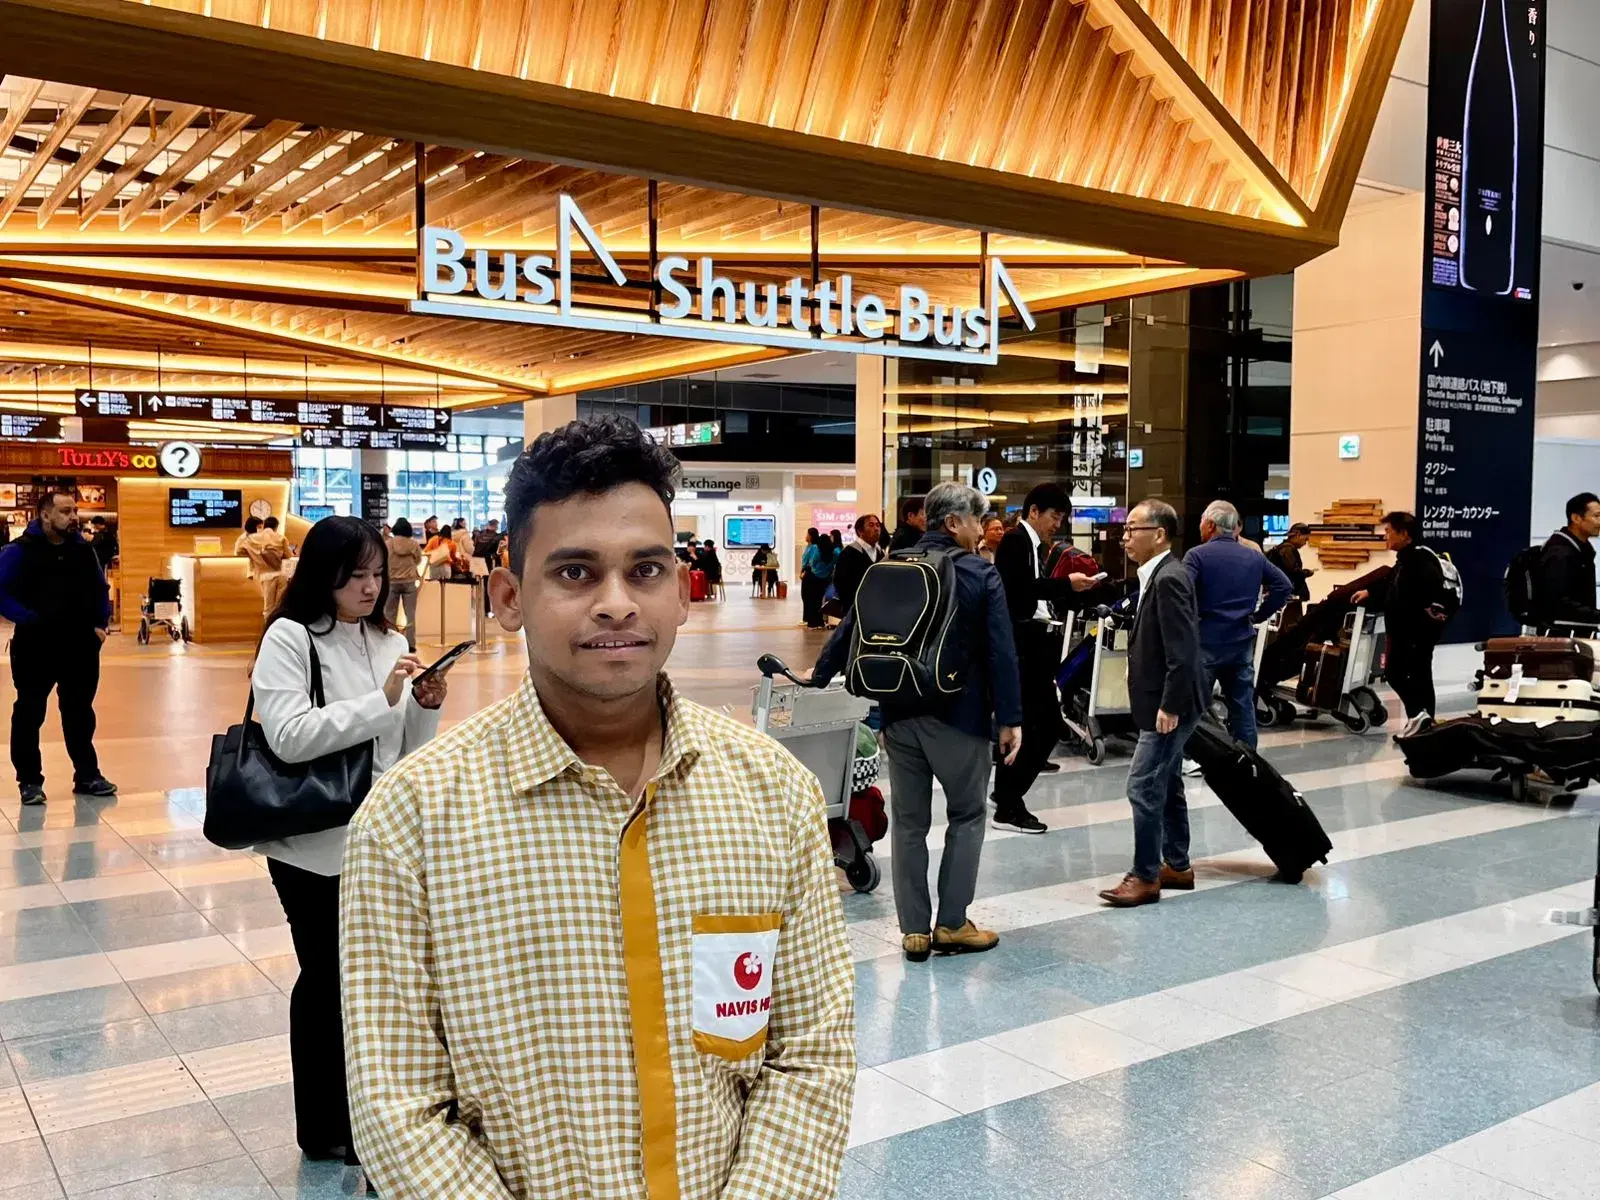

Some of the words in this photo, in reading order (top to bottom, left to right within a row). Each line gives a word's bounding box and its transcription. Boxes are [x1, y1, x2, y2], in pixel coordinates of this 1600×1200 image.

[1528, 0, 1538, 58] 香り。
[421, 226, 555, 304] Bus
[658, 256, 886, 338] Shuttle
[899, 286, 988, 349] Bus
[1425, 433, 1445, 445] Parking
[1425, 462, 1456, 475] タクシー
[681, 477, 742, 493] Exchange
[1423, 505, 1500, 519] レンタカーカウンター
[1422, 520, 1432, 529] Car
[716, 999, 758, 1018] NAVIS
